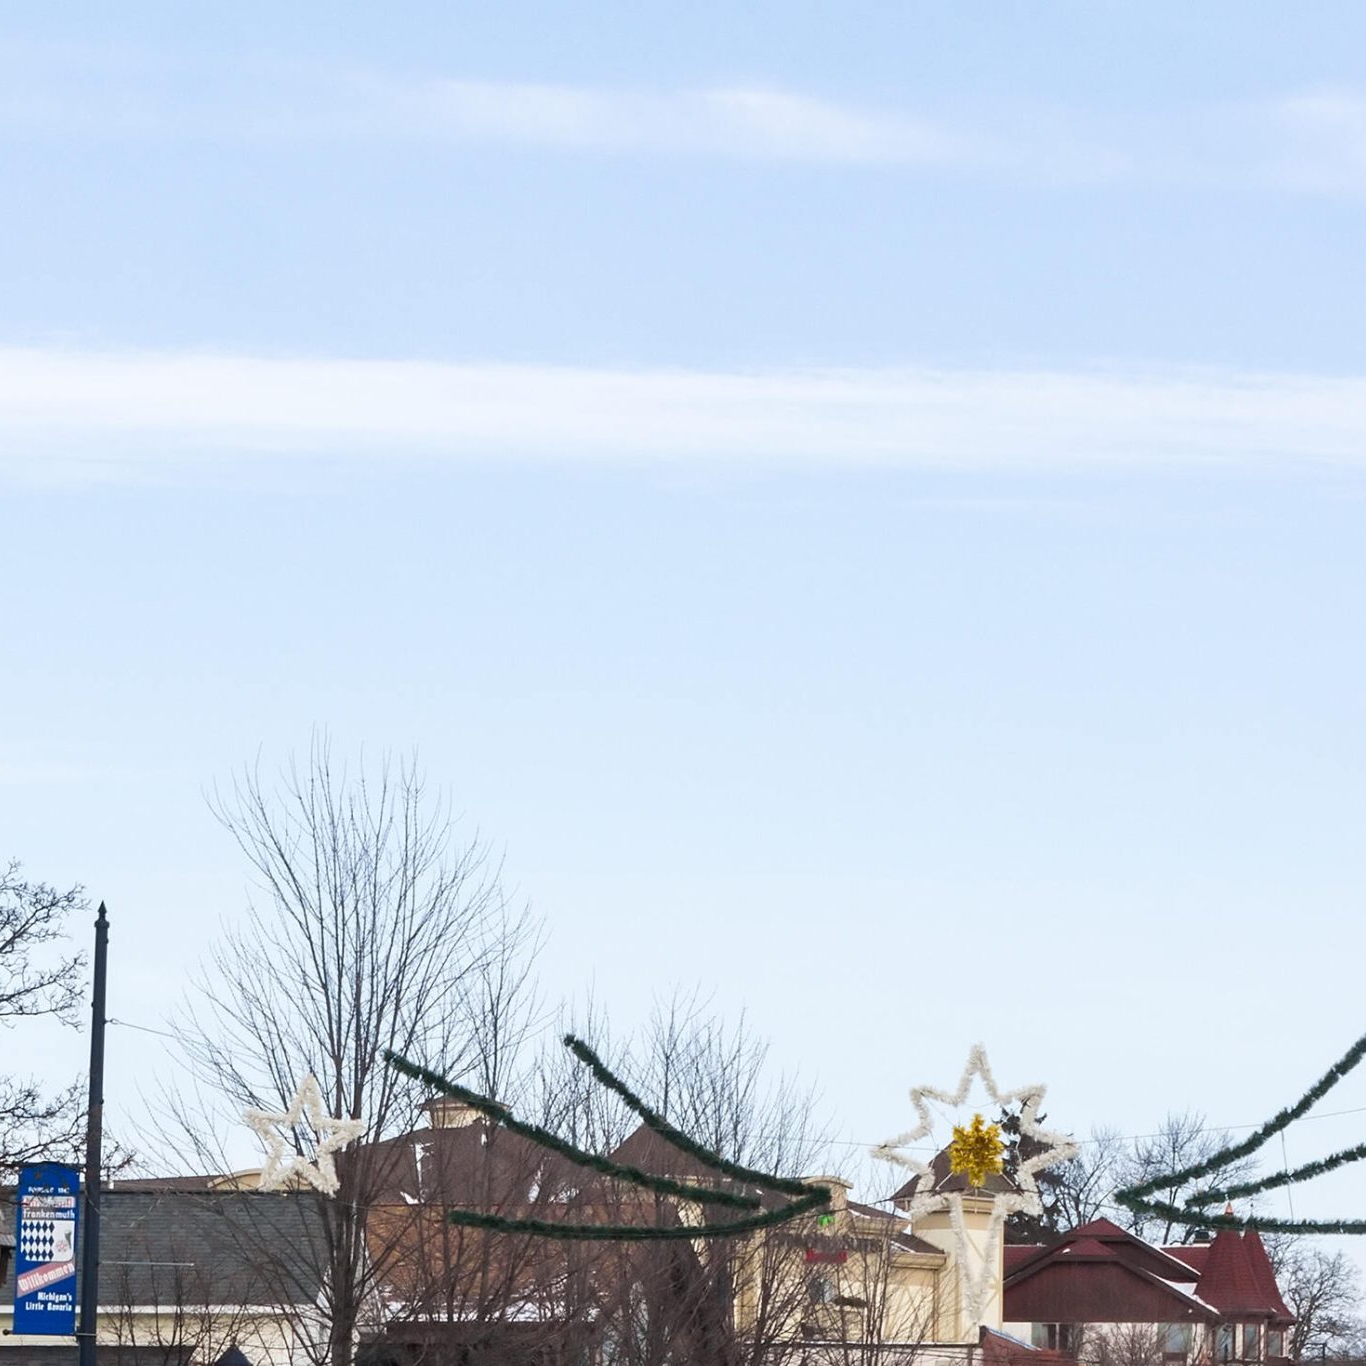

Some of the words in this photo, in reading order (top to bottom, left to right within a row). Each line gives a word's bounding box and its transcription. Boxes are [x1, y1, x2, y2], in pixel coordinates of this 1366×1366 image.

[37, 1291, 72, 1303] Michigan's
[25, 1302, 44, 1311] Little
[47, 1302, 72, 1312] Bavaria
